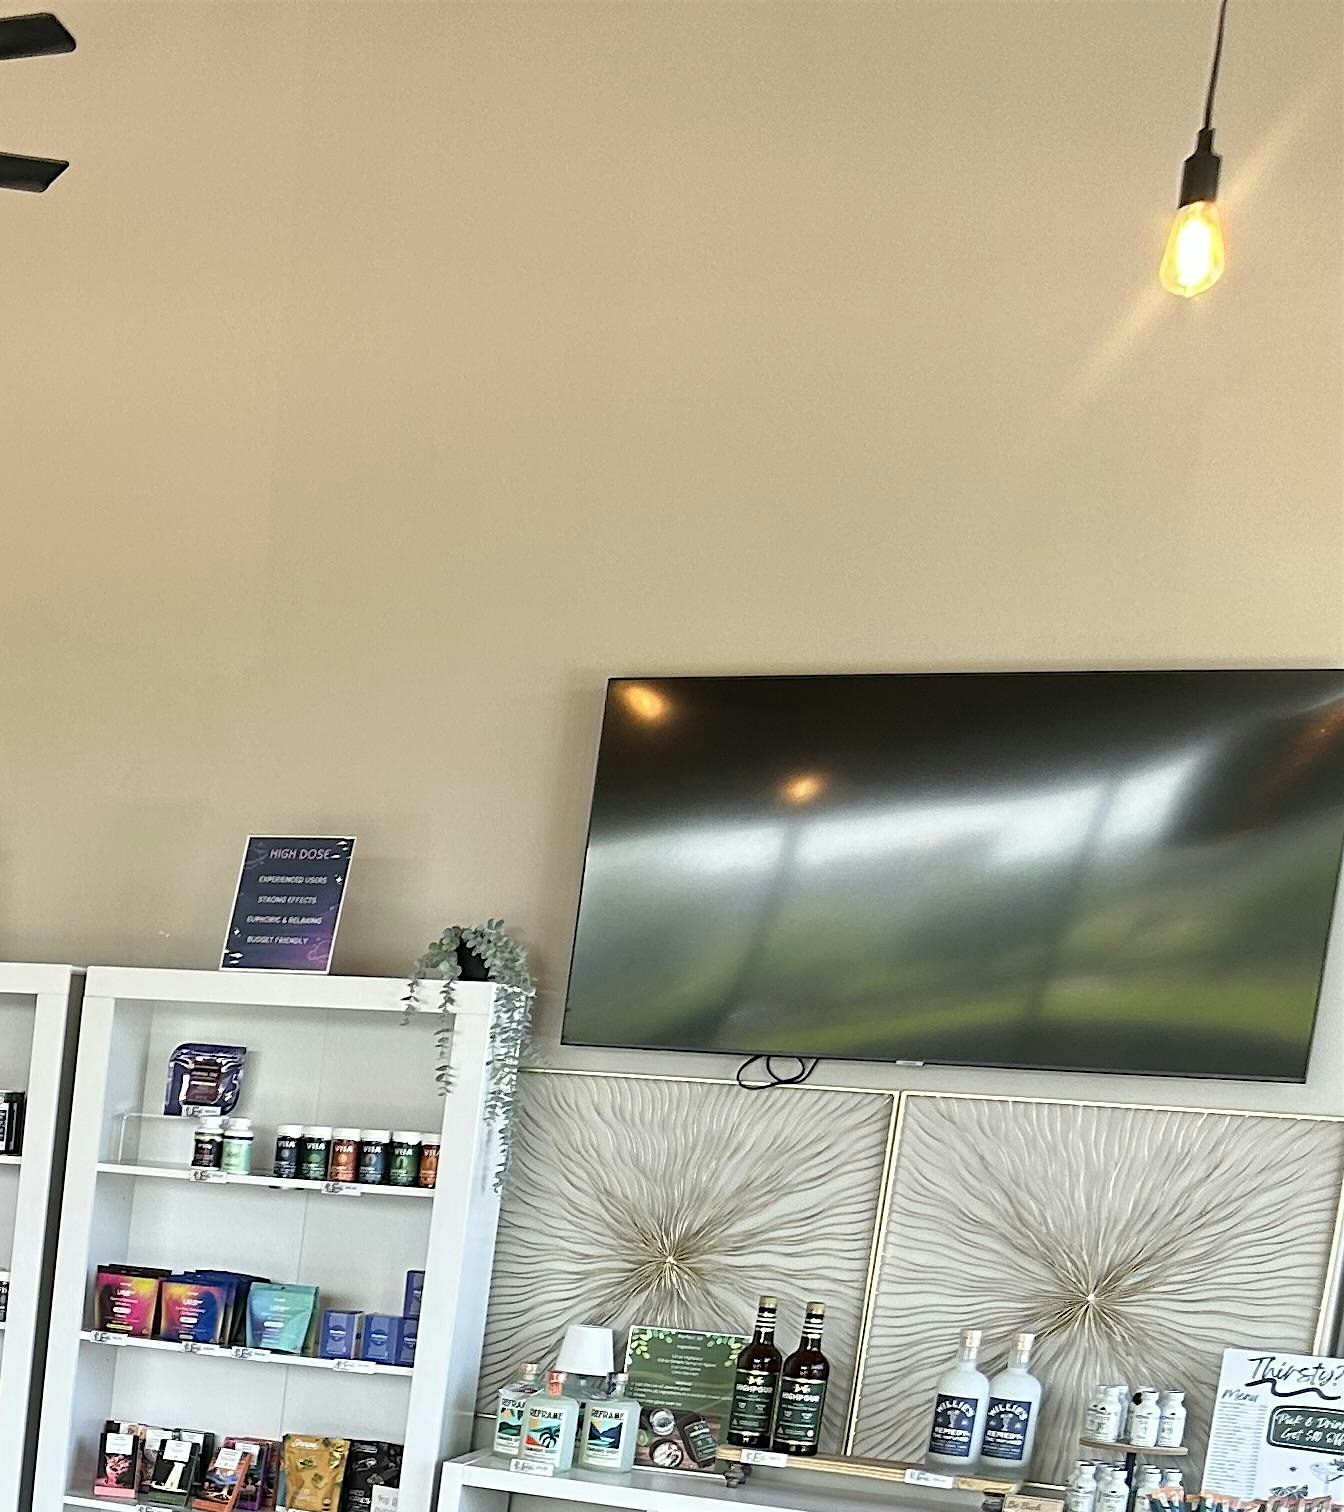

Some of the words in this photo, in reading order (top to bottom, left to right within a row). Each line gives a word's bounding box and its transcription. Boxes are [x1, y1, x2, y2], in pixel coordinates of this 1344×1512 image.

[270, 848, 296, 860] HIGH
[298, 848, 331, 860] DOSE
[258, 875, 304, 884] EXPERIENCED
[305, 876, 328, 885] USERS
[257, 895, 286, 904] STRONG
[287, 896, 317, 905] EFFECTS
[246, 915, 281, 924] EUPHORIC
[288, 916, 323, 925] RELAXING
[246, 935, 273, 944] BUDGET
[274, 936, 309, 945] FRIENDLY
[1247, 1356, 1344, 1386] Thirsty?
[502, 1398, 525, 1409] REFRA
[529, 1408, 564, 1420] REFRAME
[591, 1408, 625, 1420] REFRAME
[1316, 1417, 1344, 1430] Drin
